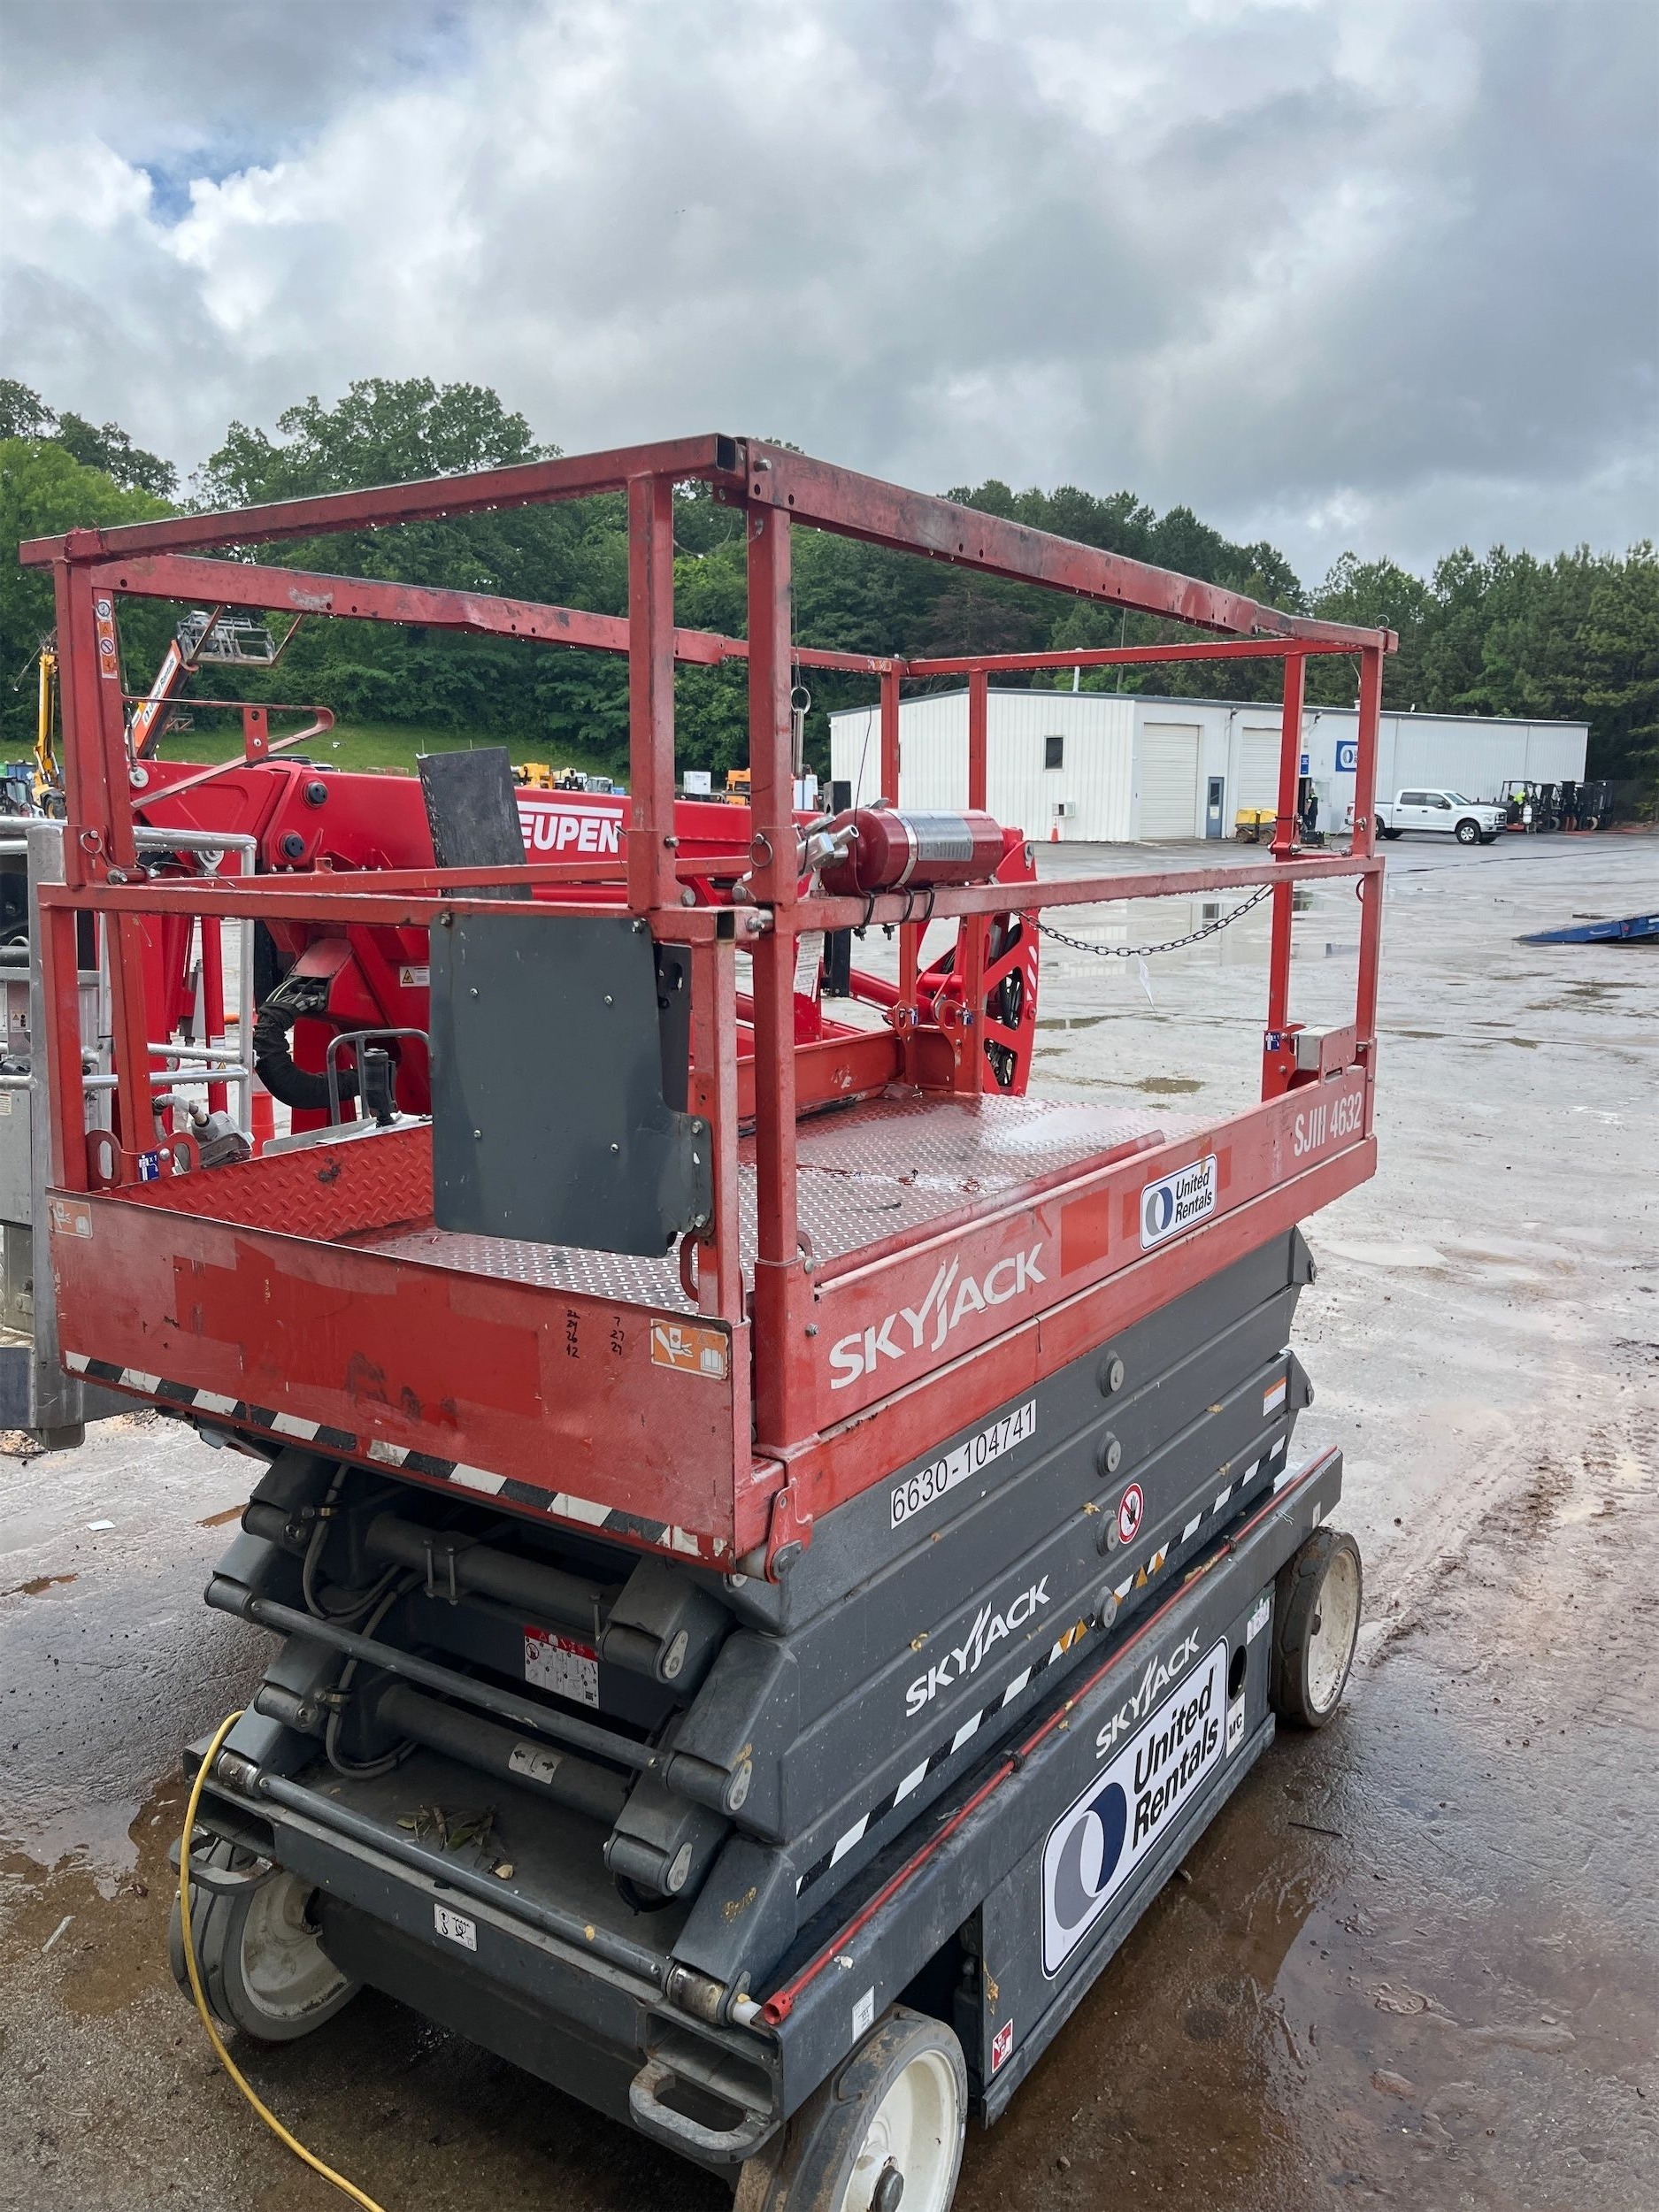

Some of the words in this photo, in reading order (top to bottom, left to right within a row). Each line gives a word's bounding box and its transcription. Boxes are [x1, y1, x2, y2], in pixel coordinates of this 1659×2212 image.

[519, 813, 622, 853] EUPEN
[1294, 1104, 1327, 1156] SJIII
[1330, 1091, 1362, 1139] 4632
[1176, 1166, 1210, 1201] United
[1176, 1188, 1212, 1223] Rentals
[566, 1344, 580, 1359] 12
[610, 1330, 624, 1341] 27
[829, 1242, 1047, 1390] SKYJACK
[893, 1403, 1033, 1522] 6630-104741
[906, 1574, 1050, 1717] SKYJACK
[1096, 1626, 1200, 1760] SKYJACK
[1133, 1667, 1214, 1795] United
[1133, 1717, 1218, 1851] Rentals
